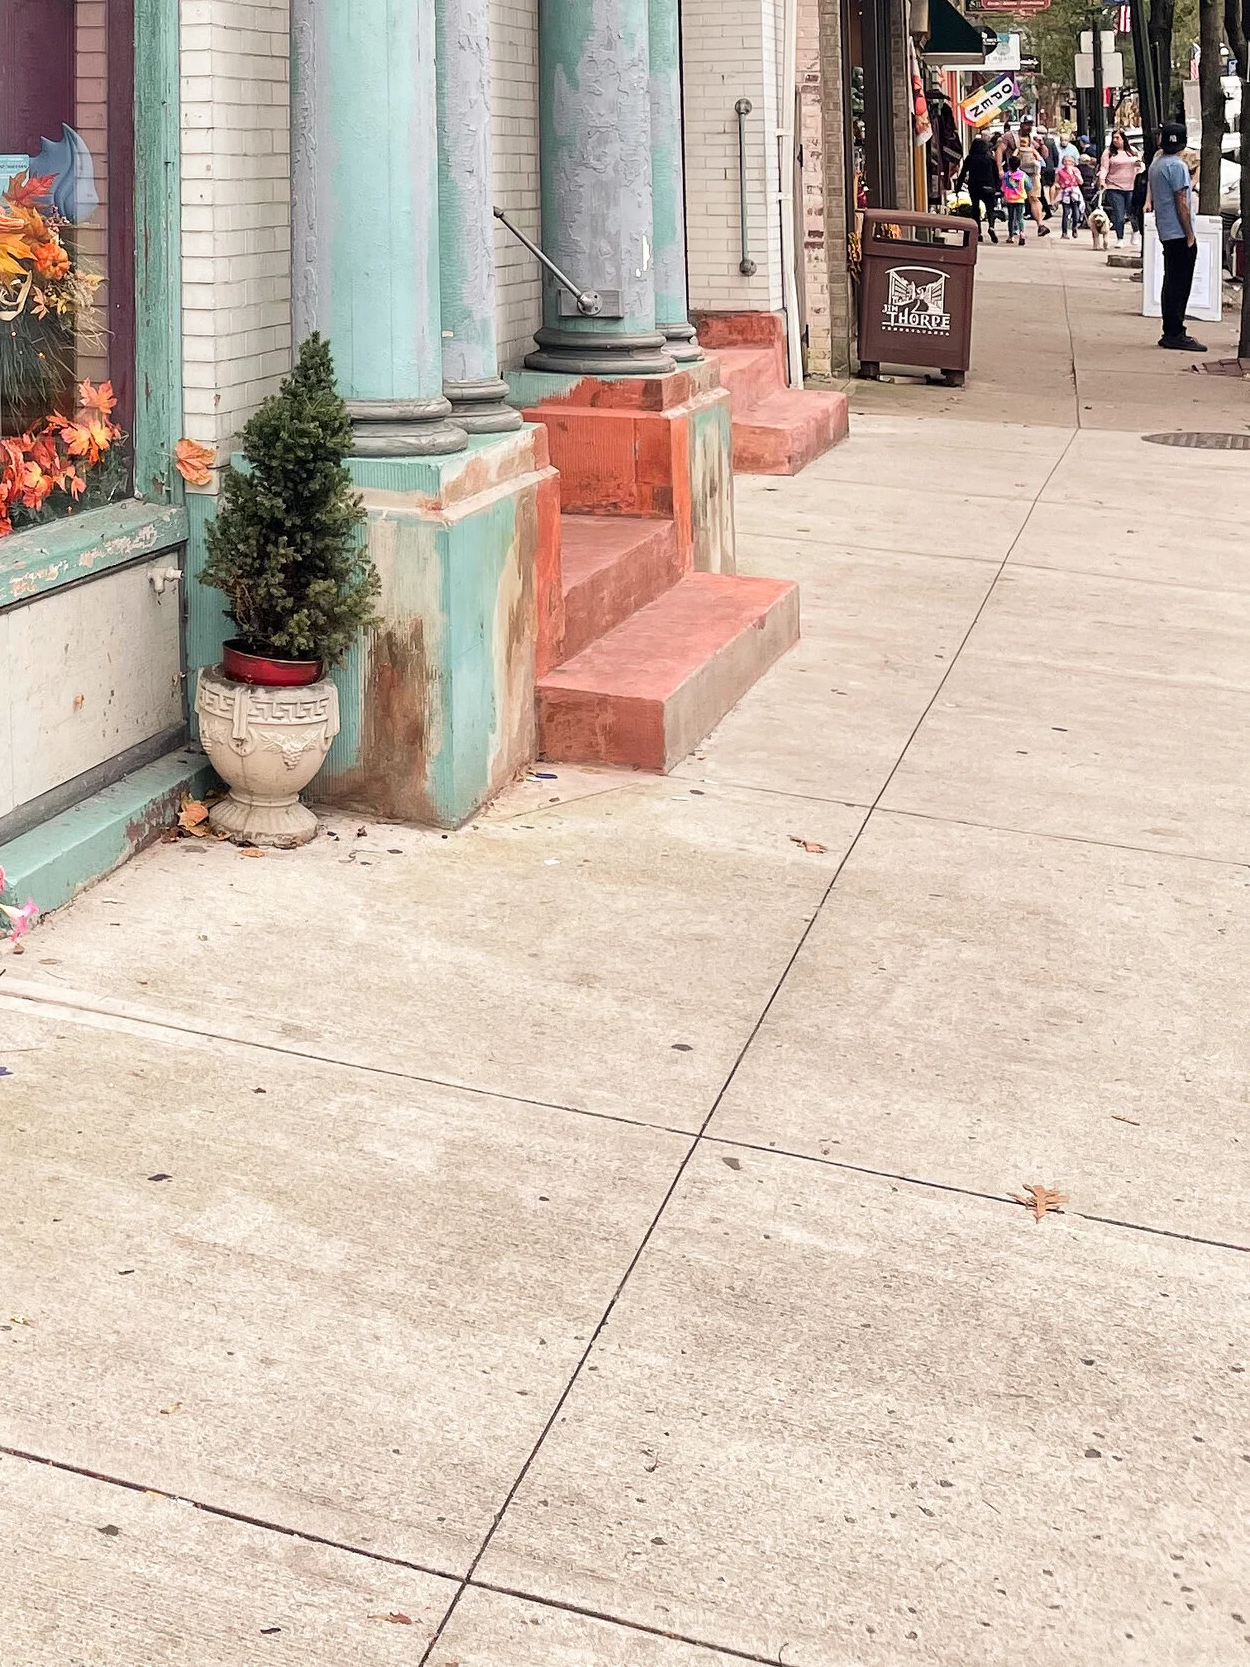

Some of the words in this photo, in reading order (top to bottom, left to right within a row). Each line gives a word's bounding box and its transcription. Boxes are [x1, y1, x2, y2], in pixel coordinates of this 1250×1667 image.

[969, 83, 1012, 118] OPEN
[882, 304, 899, 313] JIM
[886, 308, 951, 330] THORPE
